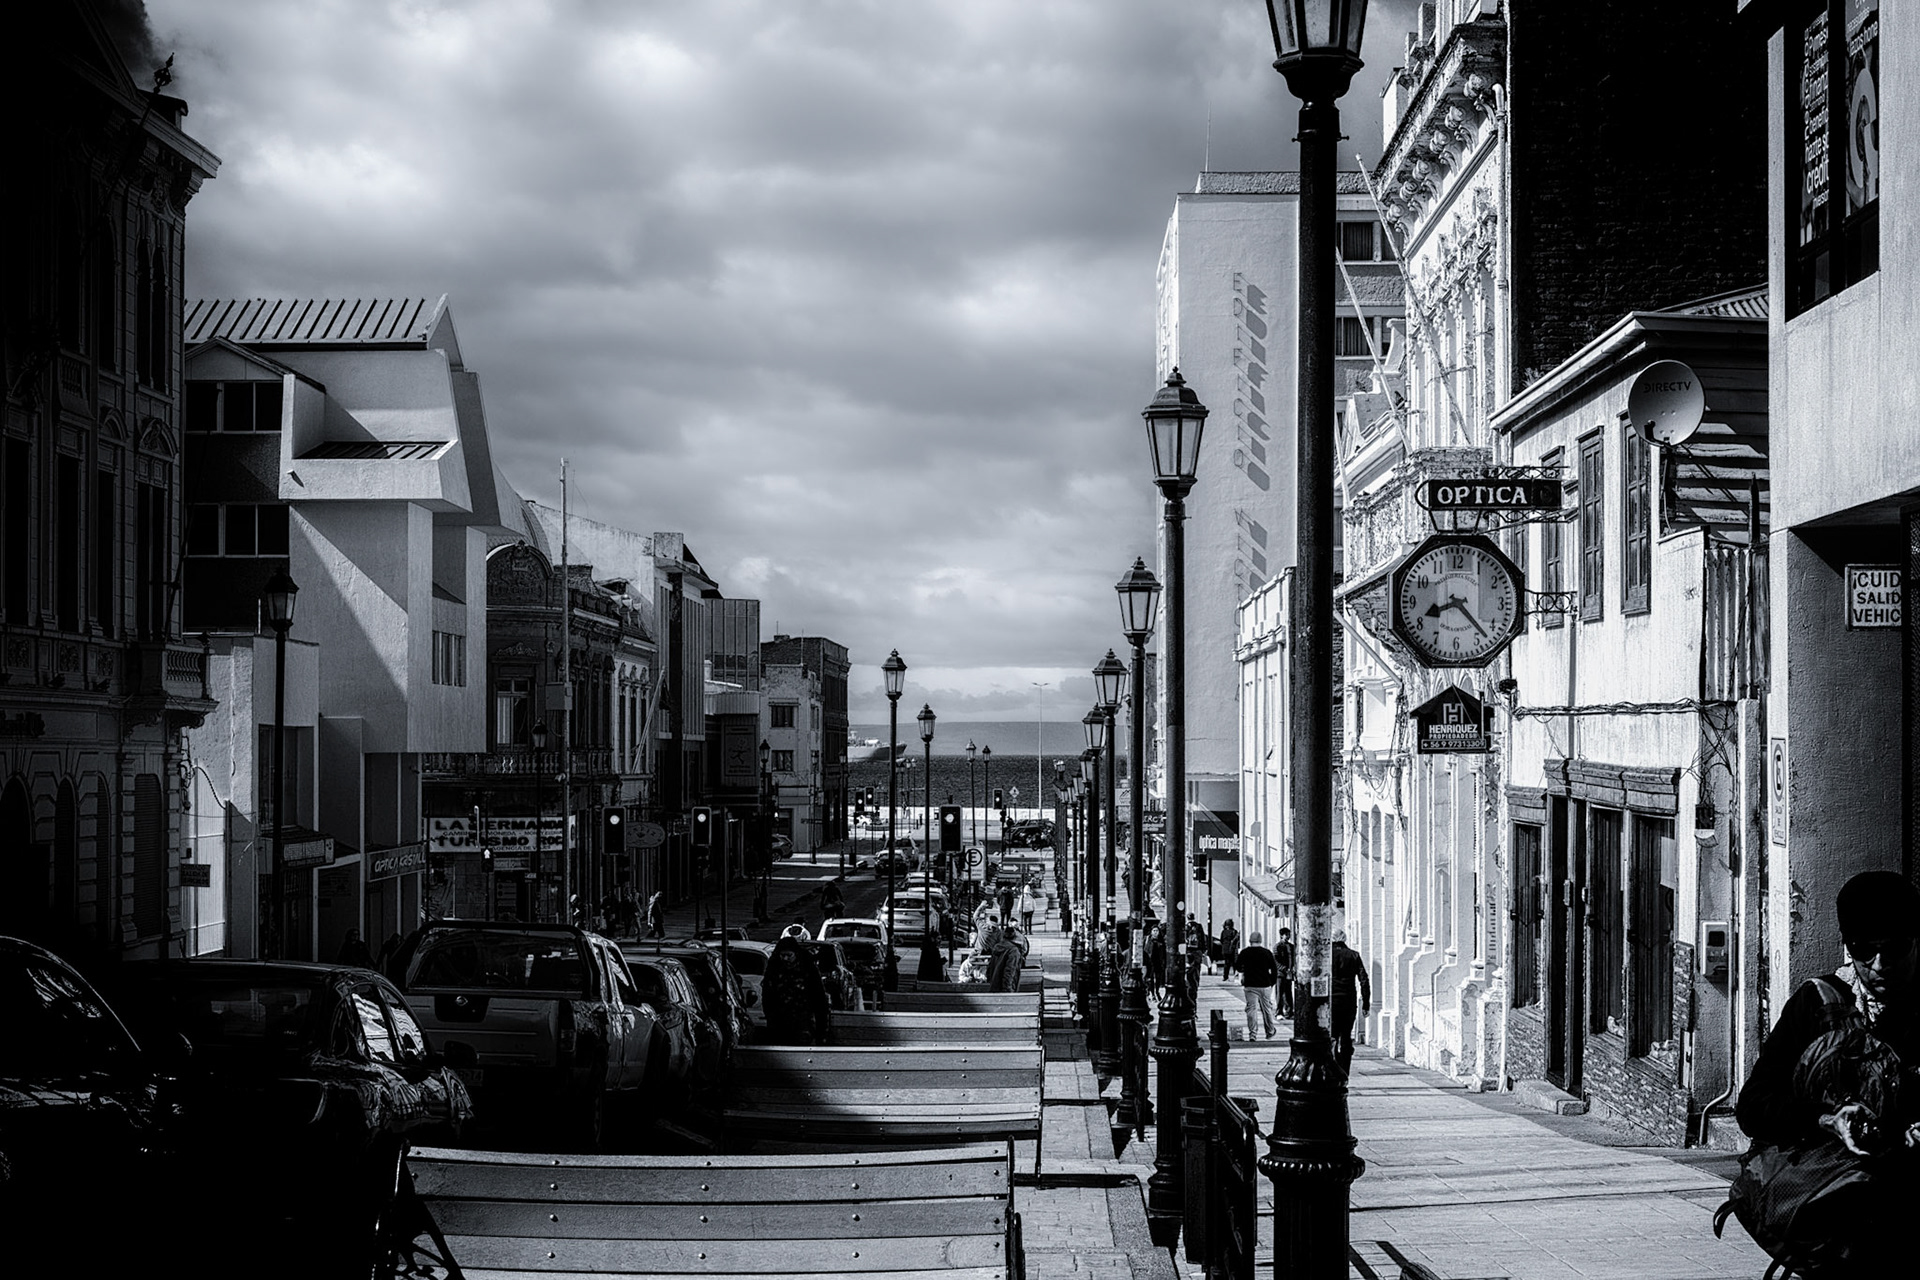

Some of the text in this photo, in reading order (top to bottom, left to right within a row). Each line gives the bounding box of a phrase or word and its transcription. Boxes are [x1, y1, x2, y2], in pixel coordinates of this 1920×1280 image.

[1643, 381, 1691, 393] DIRECTV
[1437, 486, 1527, 504] OPTICA
[1453, 555, 1463, 569] 12
[1417, 575, 1429, 588] 10
[1491, 575, 1498, 589] 2
[1409, 595, 1416, 609] 9
[1497, 597, 1504, 611] 3
[1416, 617, 1423, 631] 8
[1489, 618, 1496, 631] 4
[1433, 631, 1439, 645] 7
[1453, 637, 1460, 650] 6
[1473, 632, 1480, 646] 5
[1429, 724, 1478, 733] HENRIQUEZ
